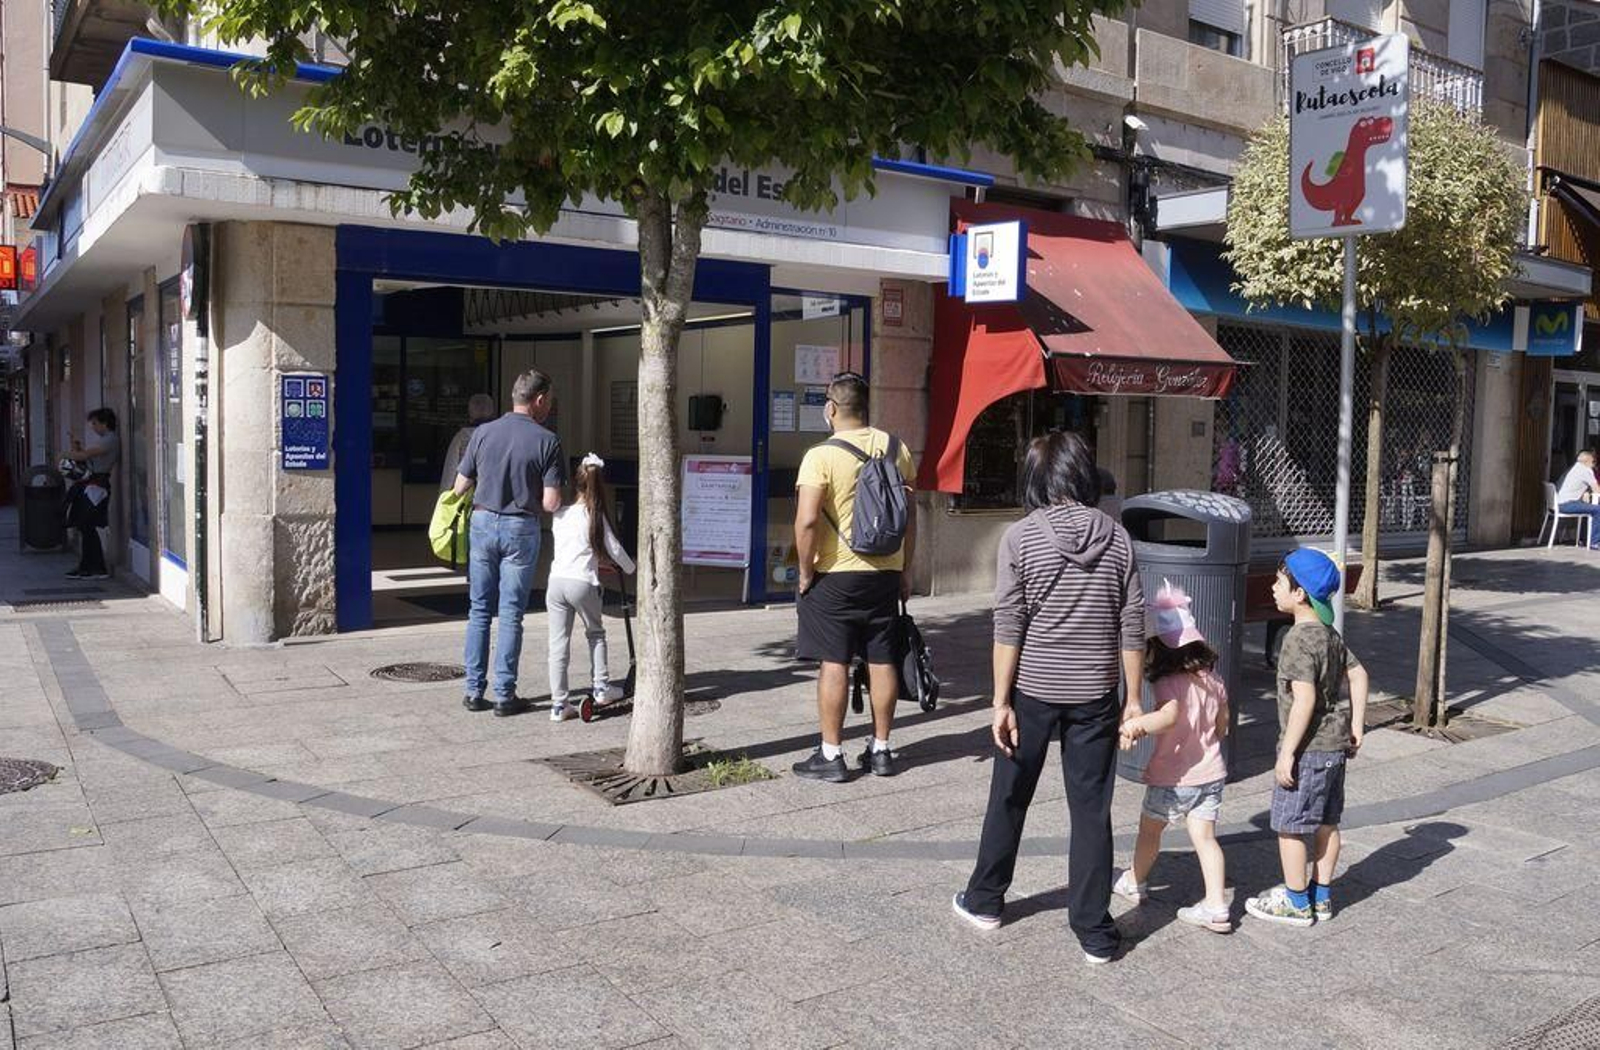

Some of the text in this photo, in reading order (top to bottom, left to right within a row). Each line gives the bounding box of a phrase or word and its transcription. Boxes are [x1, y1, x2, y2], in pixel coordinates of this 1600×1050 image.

[1315, 58, 1352, 70] CONCELLO
[1331, 66, 1347, 74] VIGO
[1296, 74, 1399, 114] Rutaescola
[713, 167, 749, 196] del
